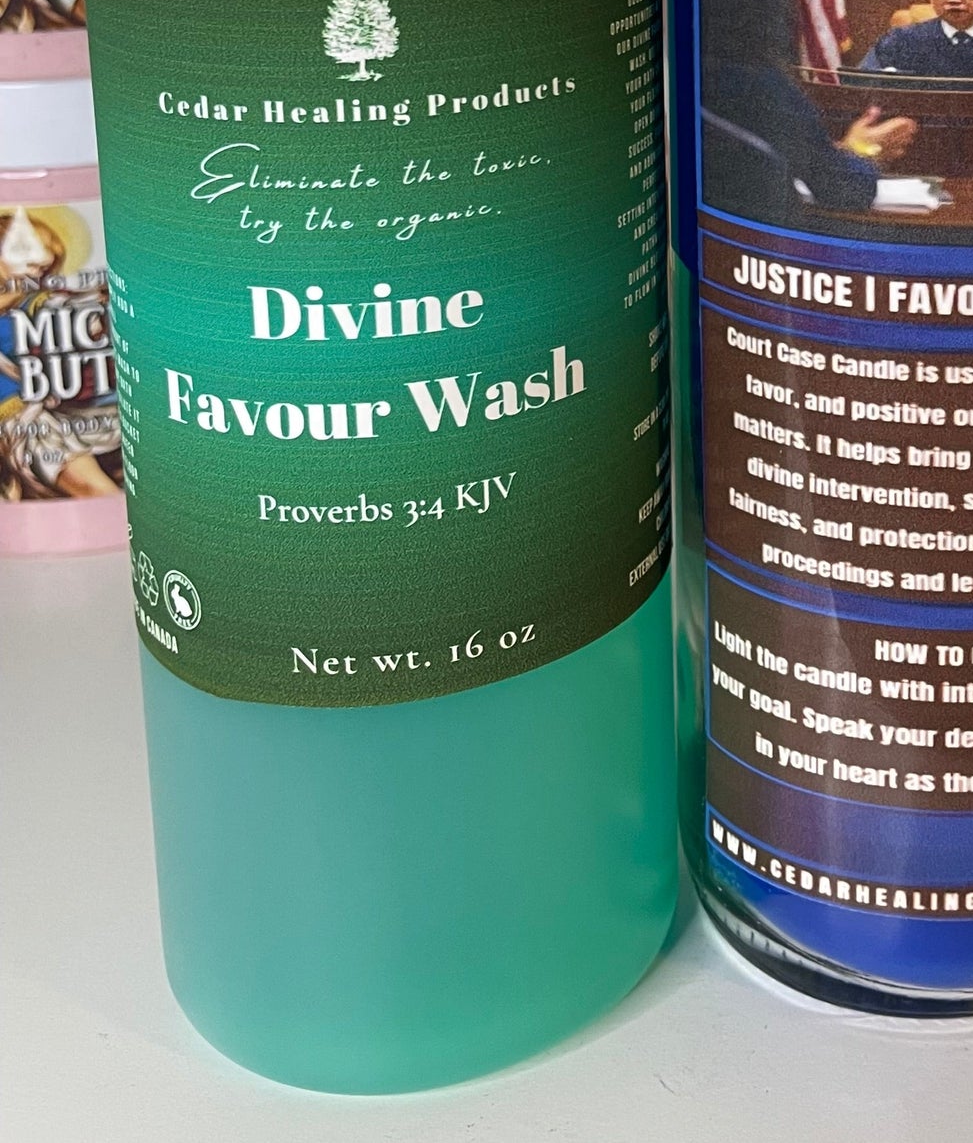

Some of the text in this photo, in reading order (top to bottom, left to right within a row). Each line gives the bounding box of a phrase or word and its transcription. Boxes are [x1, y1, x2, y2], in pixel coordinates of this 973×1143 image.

[159, 73, 577, 125] Cedar Healing Products
[190, 143, 380, 204] Eliminate
[402, 159, 452, 186] the
[239, 204, 283, 244] try
[305, 206, 354, 232] the
[733, 255, 853, 309] JUSTICE
[12, 308, 110, 355] MIC
[247, 282, 485, 341] Divine
[727, 325, 772, 359] Court
[777, 341, 826, 371] Case
[831, 353, 910, 381] Candle
[916, 360, 939, 384] is
[163, 367, 391, 440] Favour
[404, 345, 587, 433] Wash
[804, 391, 845, 416] and
[851, 399, 946, 427] positive
[816, 433, 831, 456] It
[836, 437, 901, 466] helps
[907, 445, 971, 471] bring
[257, 472, 517, 527] Proverbs 3:4 KJV
[746, 455, 804, 491] divine
[808, 470, 956, 513] intervention,
[812, 515, 853, 542] and
[761, 542, 895, 590] proceedings
[900, 568, 945, 593] and
[147, 615, 178, 654] CANADA
[292, 623, 537, 676] Net wt. 16 oz
[714, 620, 752, 662] Light
[757, 647, 788, 674] the
[793, 660, 873, 696] candle
[880, 677, 935, 702] with
[874, 639, 927, 666] HOW
[936, 645, 963, 667] TO
[711, 663, 746, 701] your
[749, 684, 797, 723] goal.
[803, 708, 874, 742] Speak
[879, 724, 936, 748] your
[755, 732, 773, 758] in
[778, 745, 828, 778] your
[833, 758, 898, 790] heart
[903, 773, 936, 792] as
